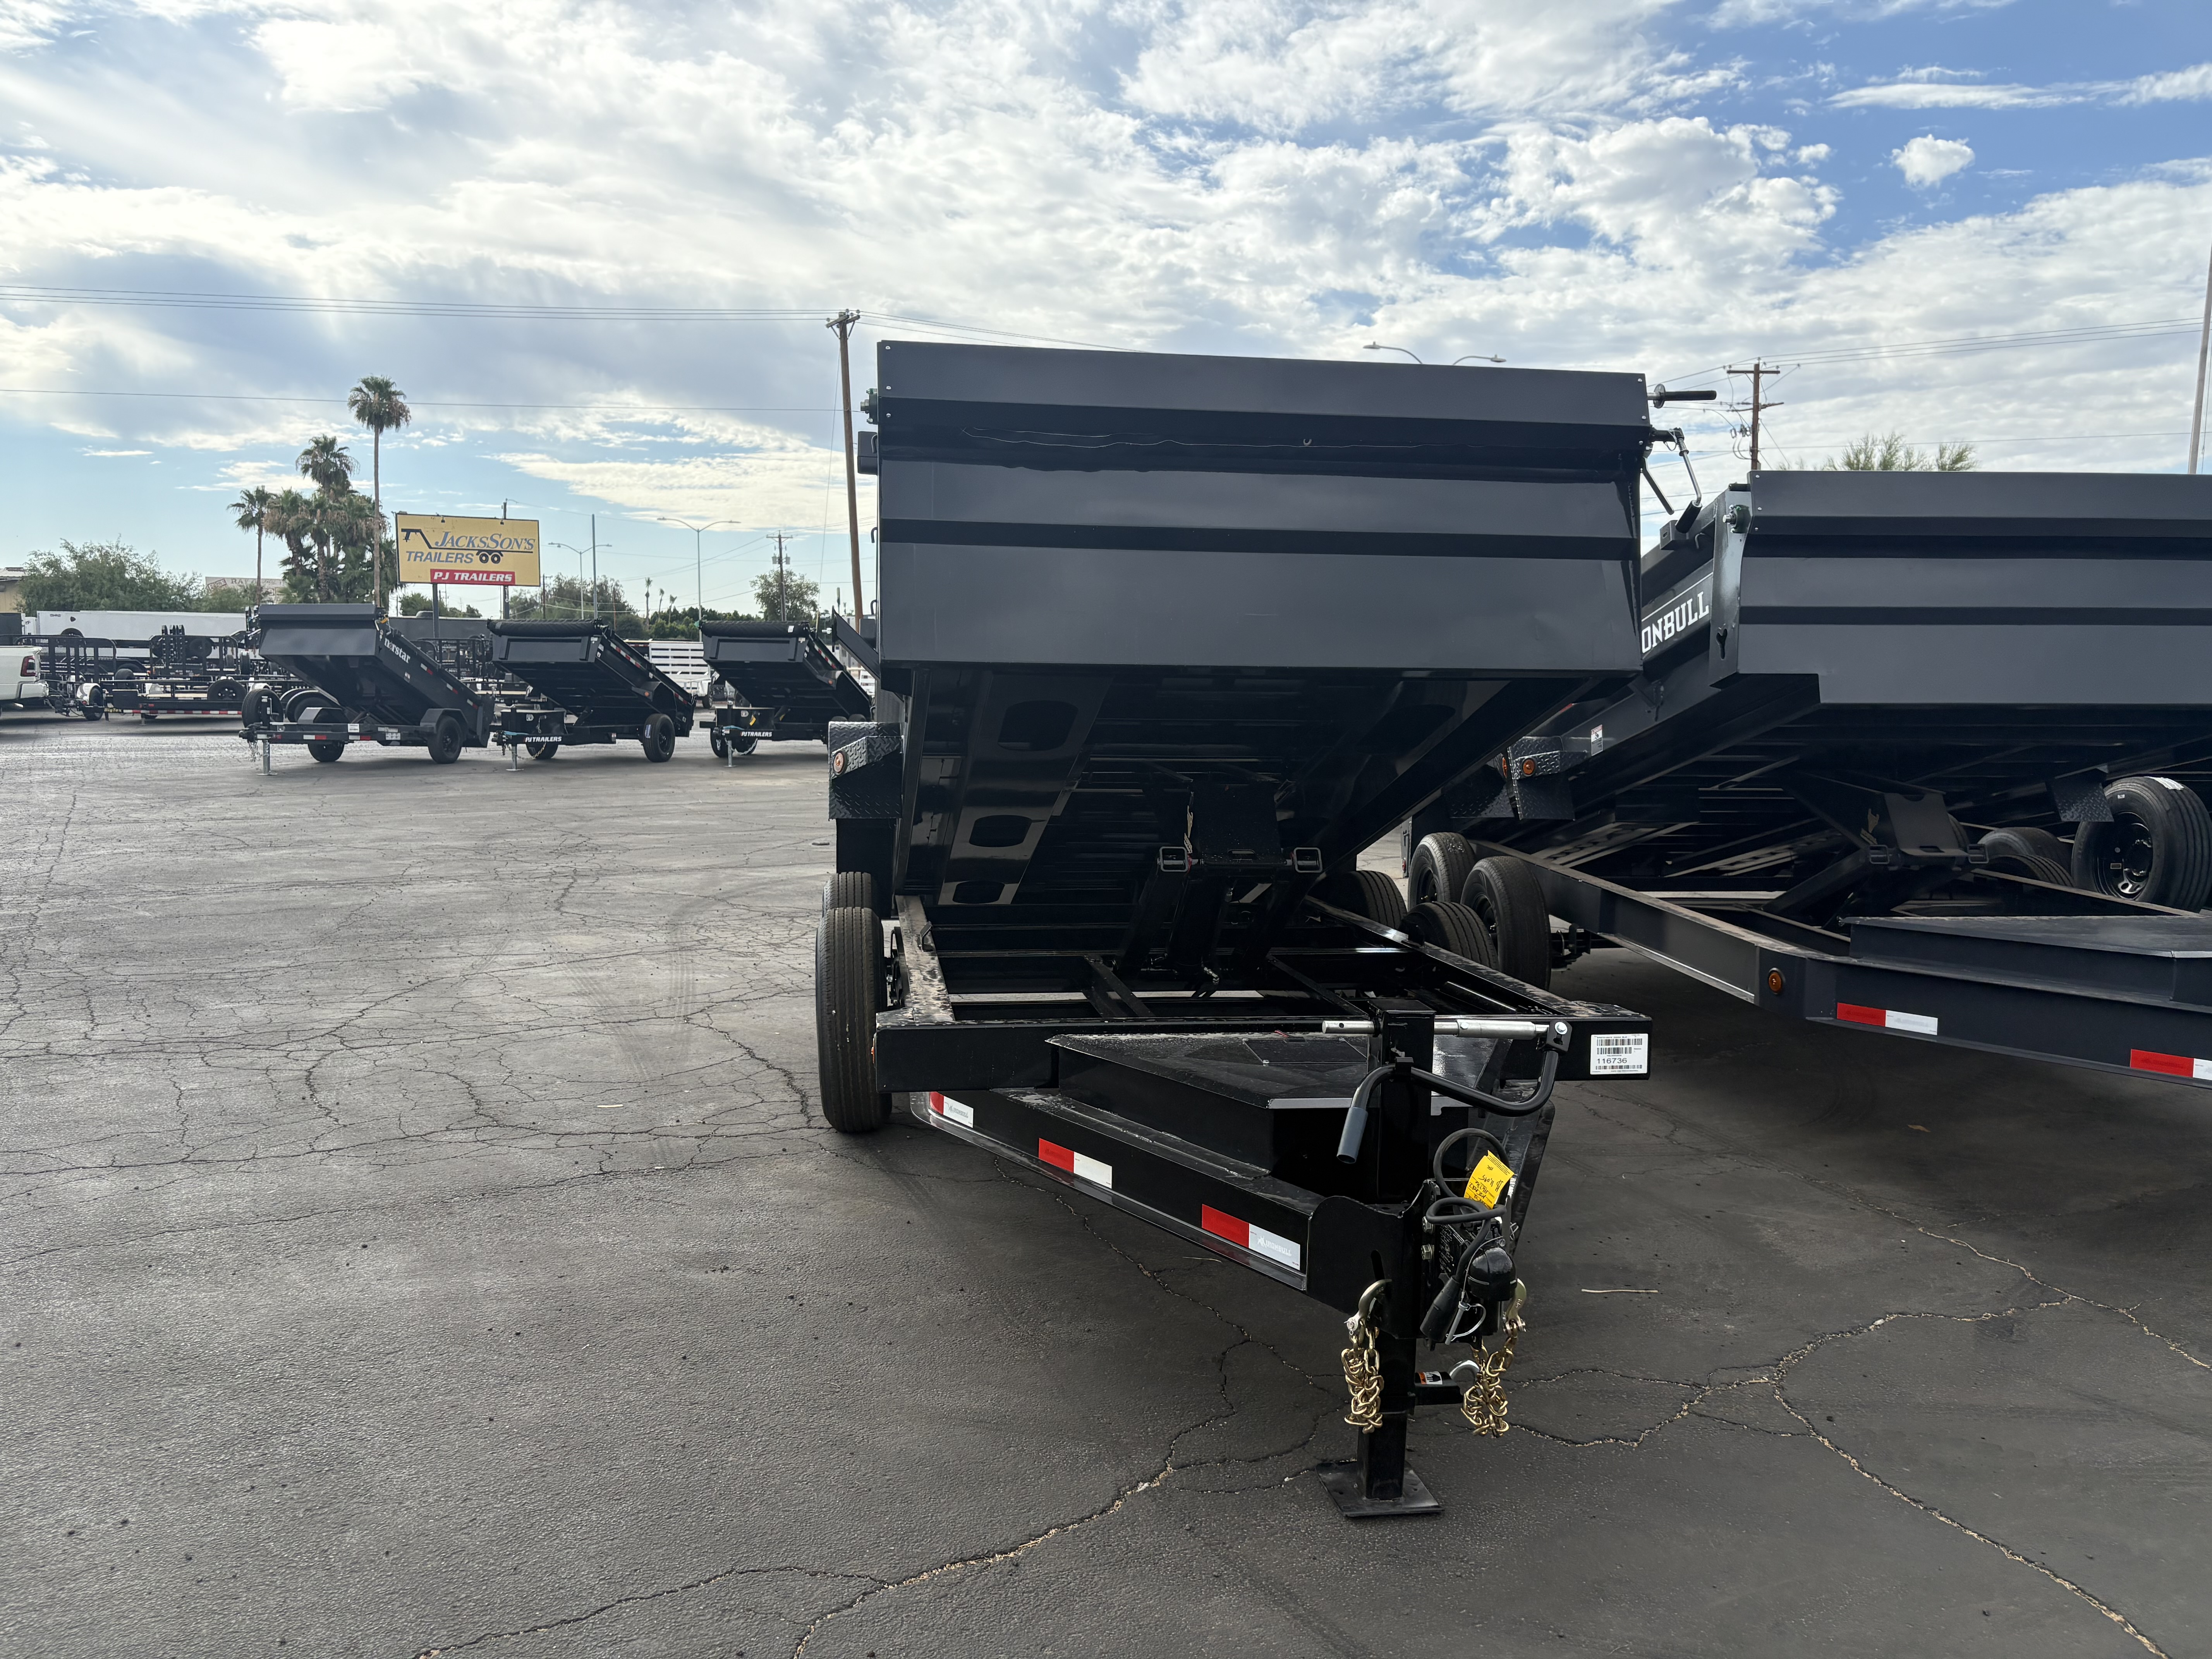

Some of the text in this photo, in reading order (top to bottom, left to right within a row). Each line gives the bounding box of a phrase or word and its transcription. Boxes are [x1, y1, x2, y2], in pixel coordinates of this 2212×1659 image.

[406, 551, 474, 563] TRAILERS
[433, 572, 512, 581] PJ TRAILERS
[1642, 591, 1709, 653] ONBULL
[1265, 1240, 1292, 1257] IRONBULL
